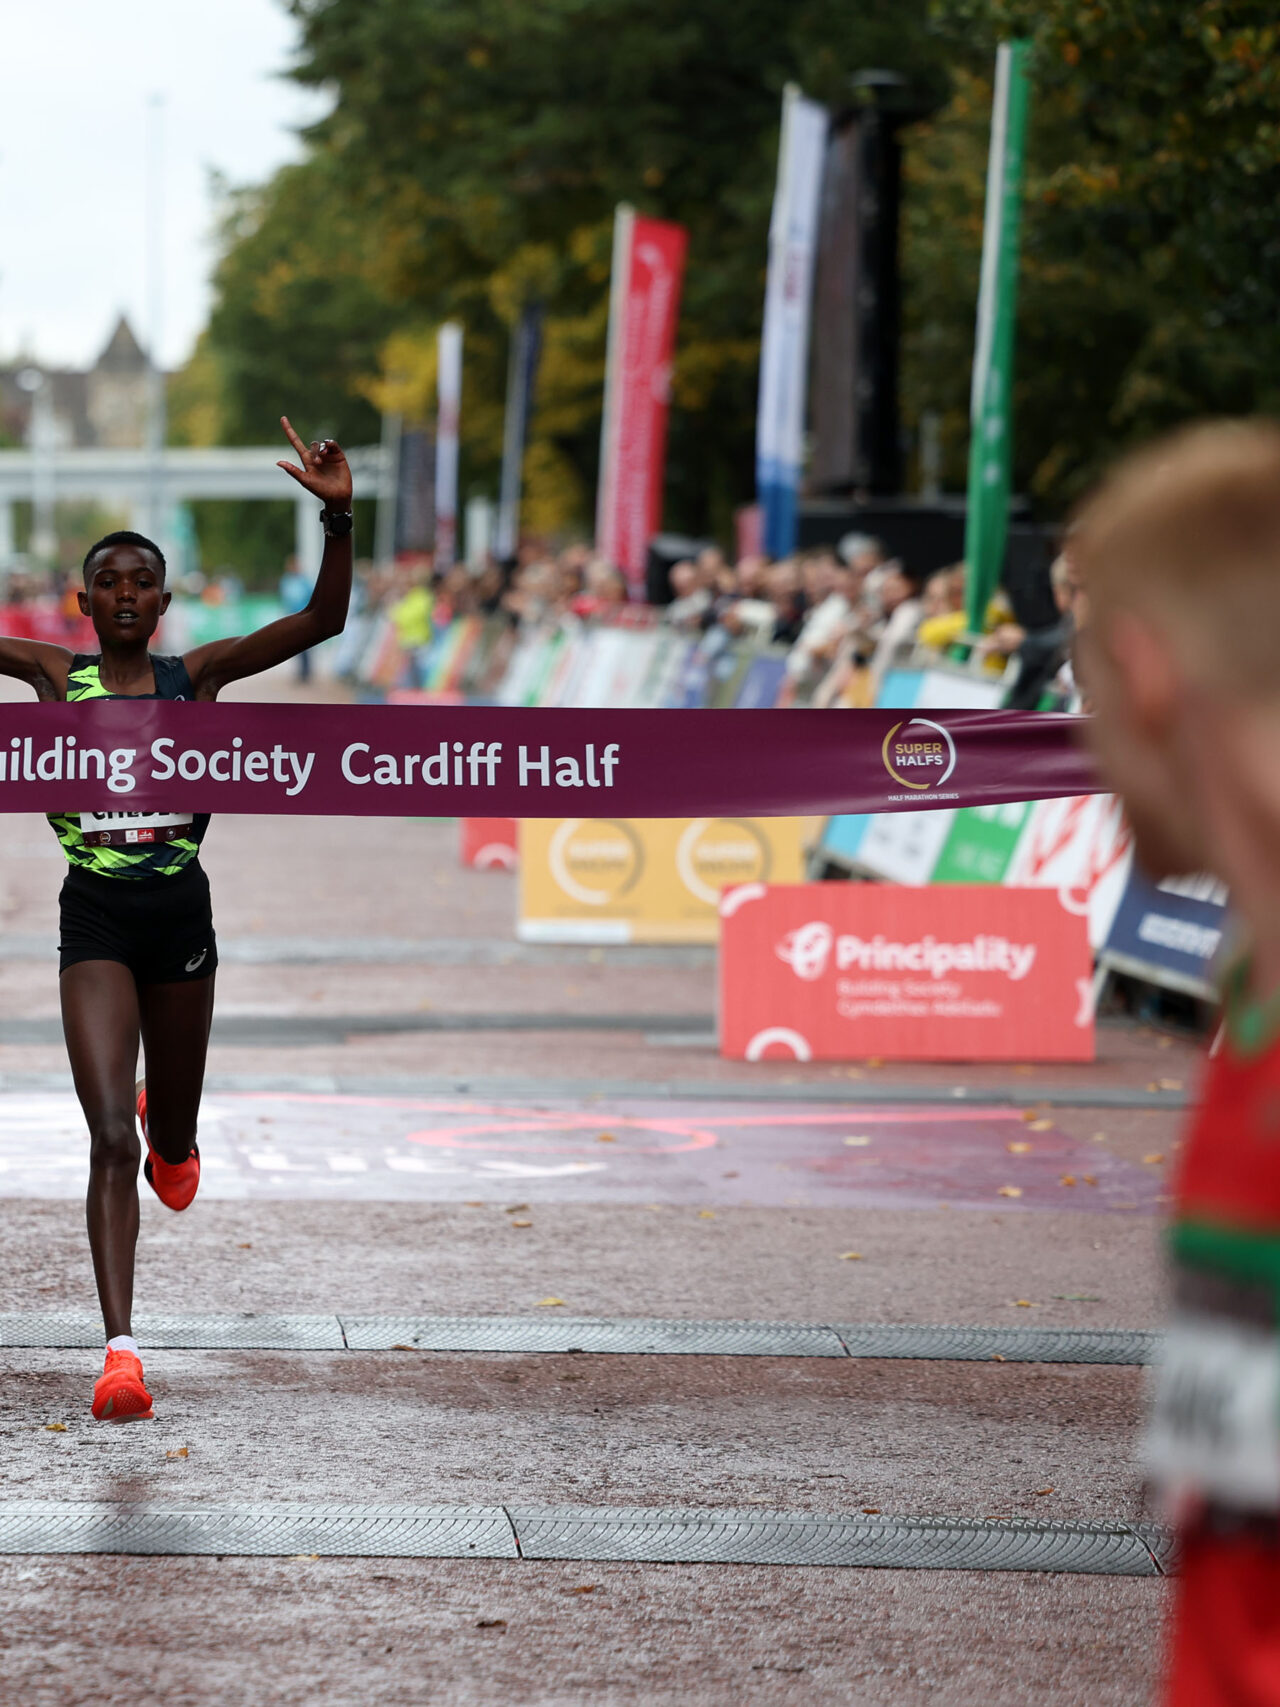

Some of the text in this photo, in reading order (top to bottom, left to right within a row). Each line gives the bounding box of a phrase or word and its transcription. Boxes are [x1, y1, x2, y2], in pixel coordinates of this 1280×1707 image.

[895, 743, 942, 754] SUPER
[896, 755, 943, 766] HALFS
[150, 737, 316, 796] Society
[341, 742, 502, 786] Cardiff
[518, 743, 620, 787] Half
[904, 793, 938, 801] MARATHON
[836, 934, 1037, 980] Principality
